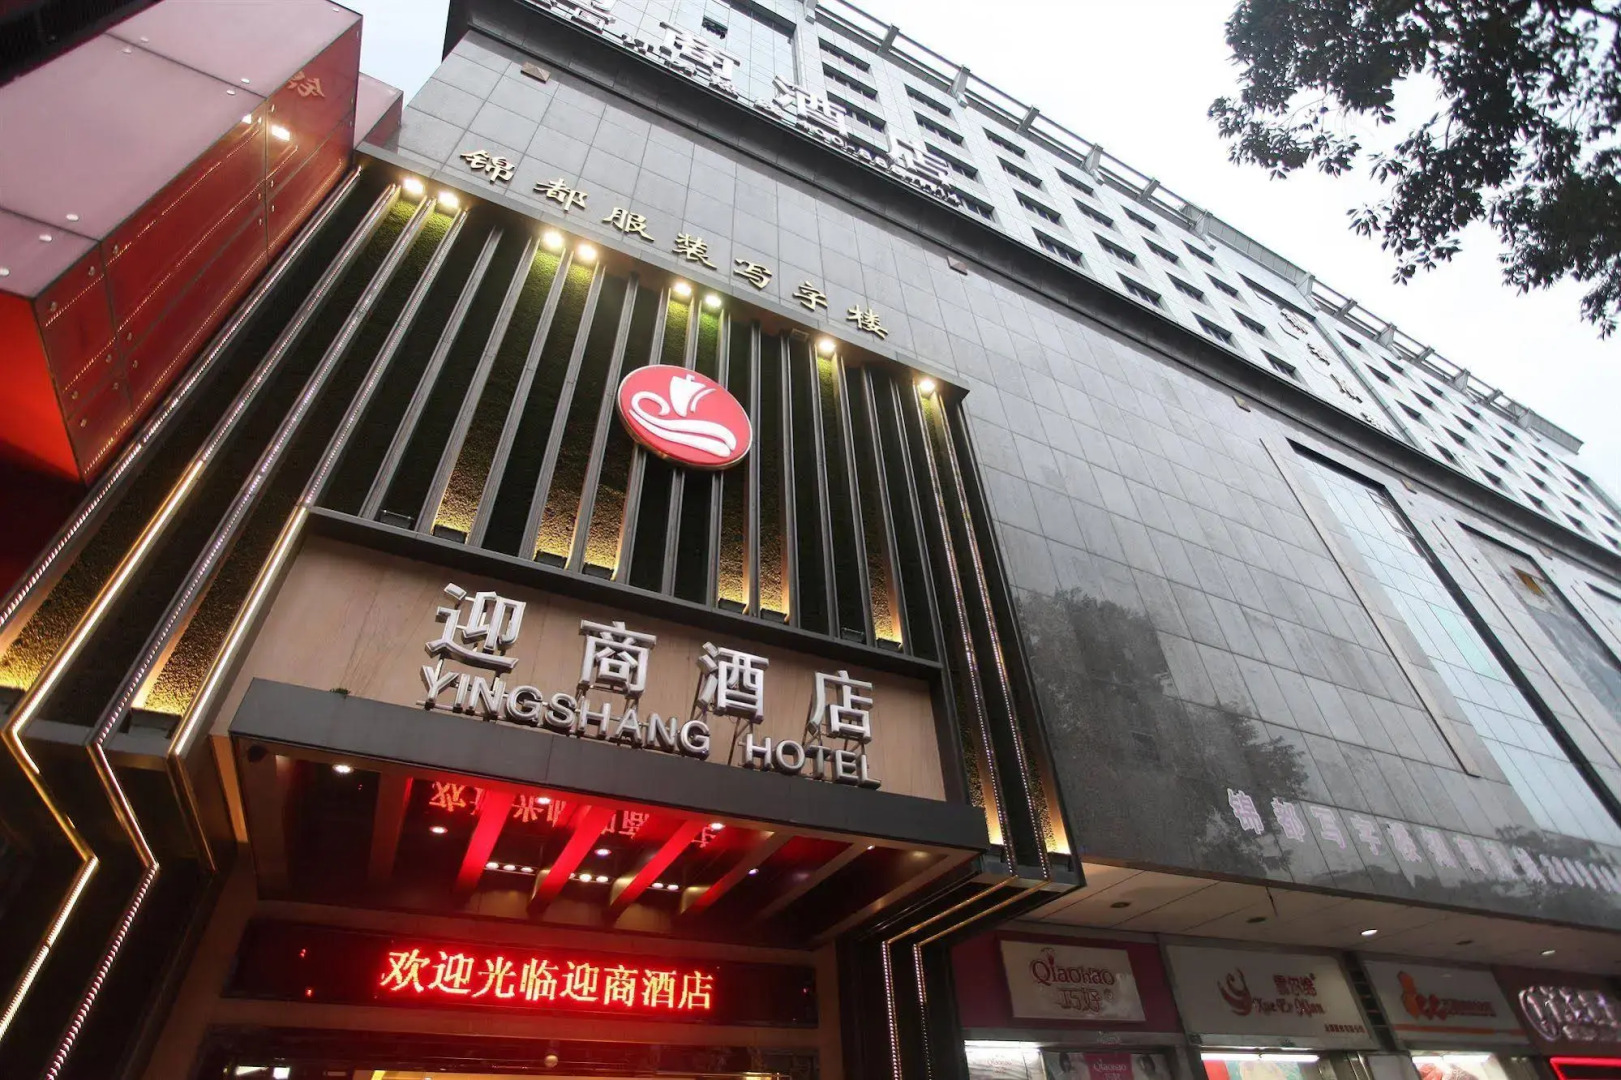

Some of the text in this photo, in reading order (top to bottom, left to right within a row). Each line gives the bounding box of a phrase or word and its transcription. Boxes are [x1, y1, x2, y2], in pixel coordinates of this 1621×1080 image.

[460, 148, 889, 340] 锦都服装写字楼
[418, 665, 882, 790] YINGSHANG HOTEL
[423, 582, 875, 743] 迎商酒店
[380, 947, 715, 1011] 欢迎光临迎商酒店
